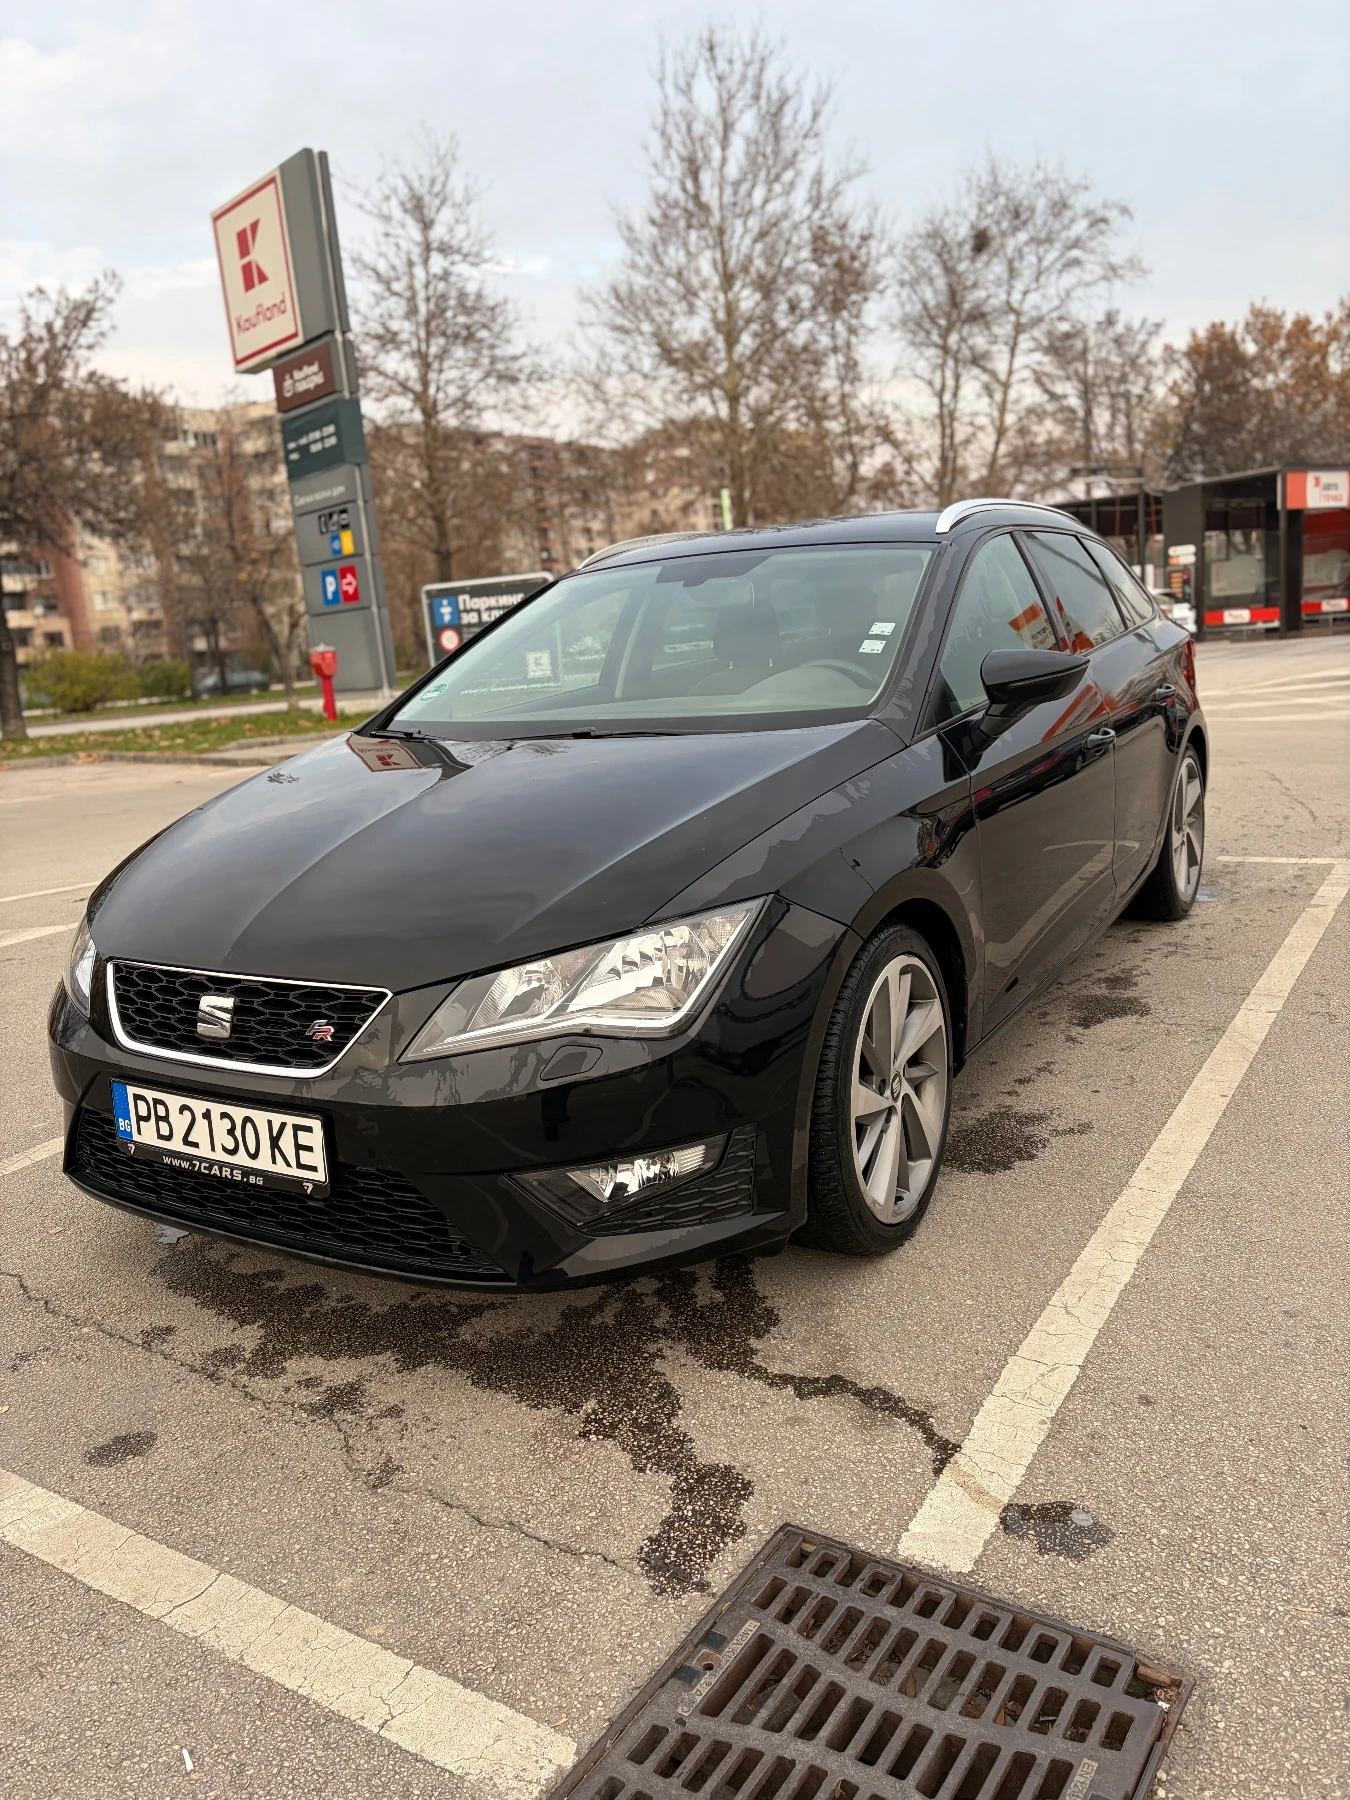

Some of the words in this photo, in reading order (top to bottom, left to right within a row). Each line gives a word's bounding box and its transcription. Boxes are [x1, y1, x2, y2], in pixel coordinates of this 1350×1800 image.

[235, 291, 287, 336] Kaufland
[325, 575, 337, 600] P
[458, 593, 525, 612] Паркинг
[459, 611, 480, 625] за
[305, 1019, 335, 1041] FR
[119, 1117, 132, 1132] BG
[178, 1103, 261, 1161] 2130
[267, 1118, 319, 1173] KE
